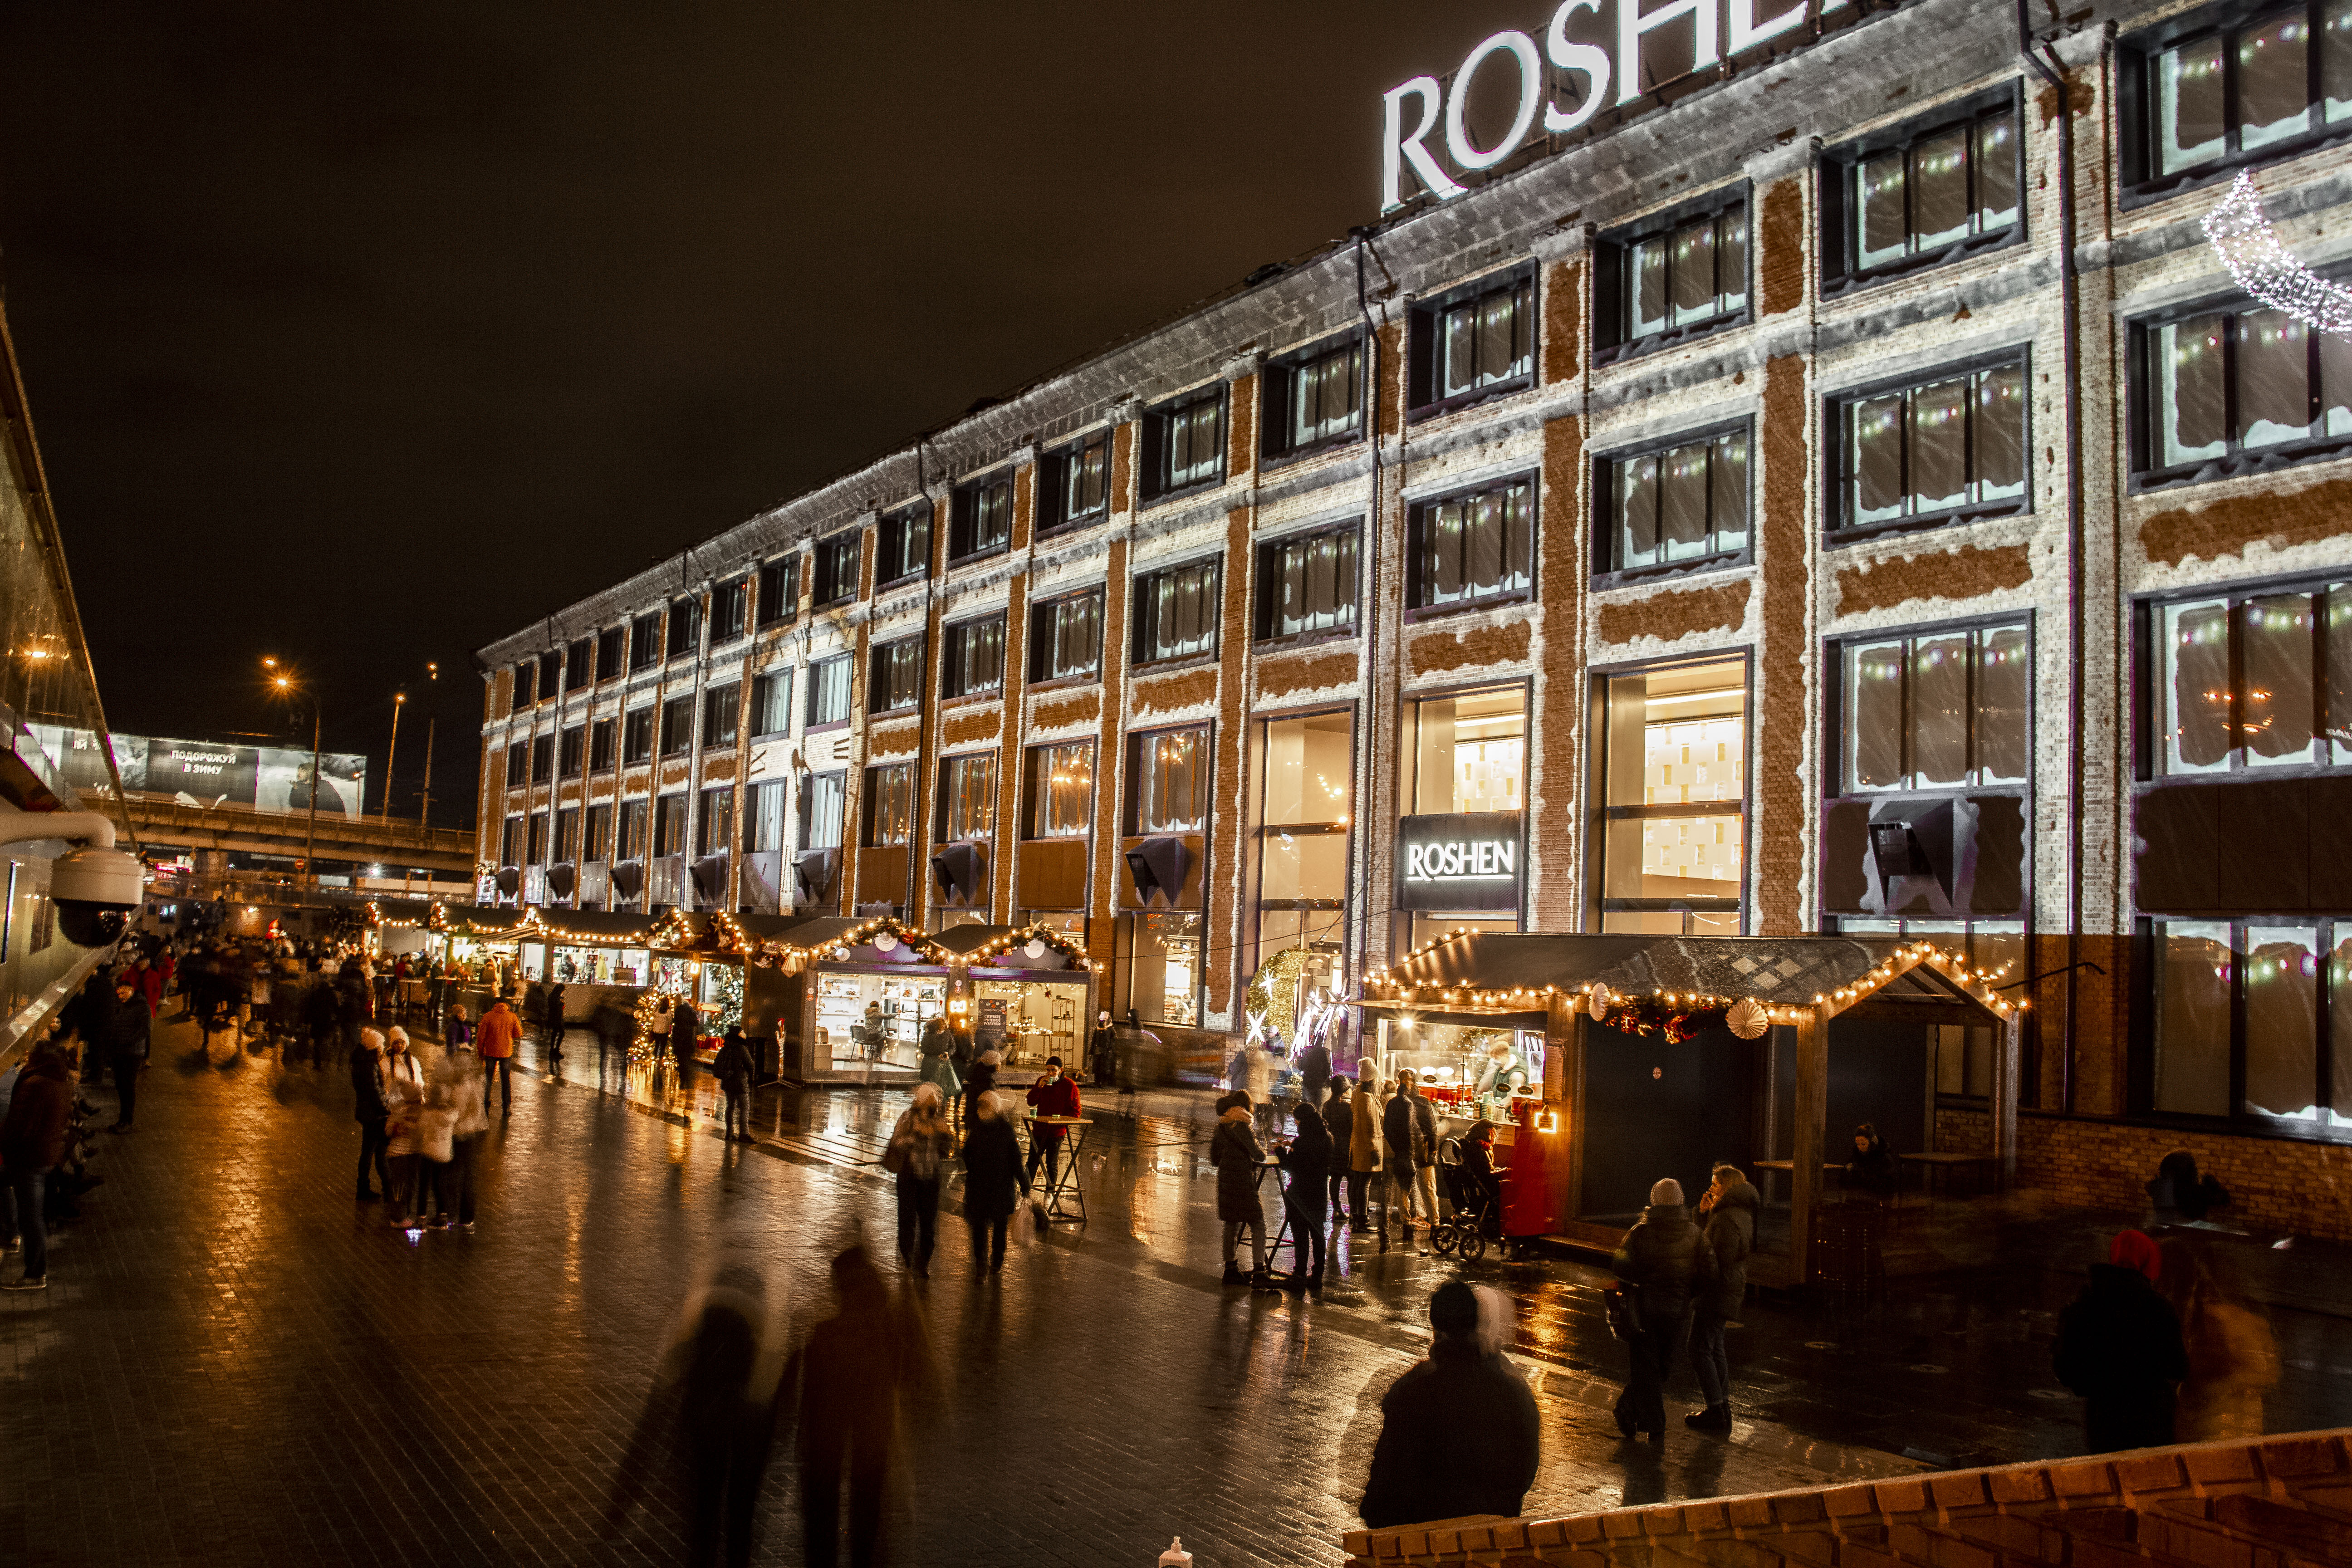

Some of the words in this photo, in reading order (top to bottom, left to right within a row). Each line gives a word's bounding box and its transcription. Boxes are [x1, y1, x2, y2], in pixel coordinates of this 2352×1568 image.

[171, 750, 236, 764] ПОДОРОЖУЙ
[183, 763, 191, 772] В
[192, 764, 223, 774] ЗИМУ
[1408, 841, 1514, 881] ROSHEN
